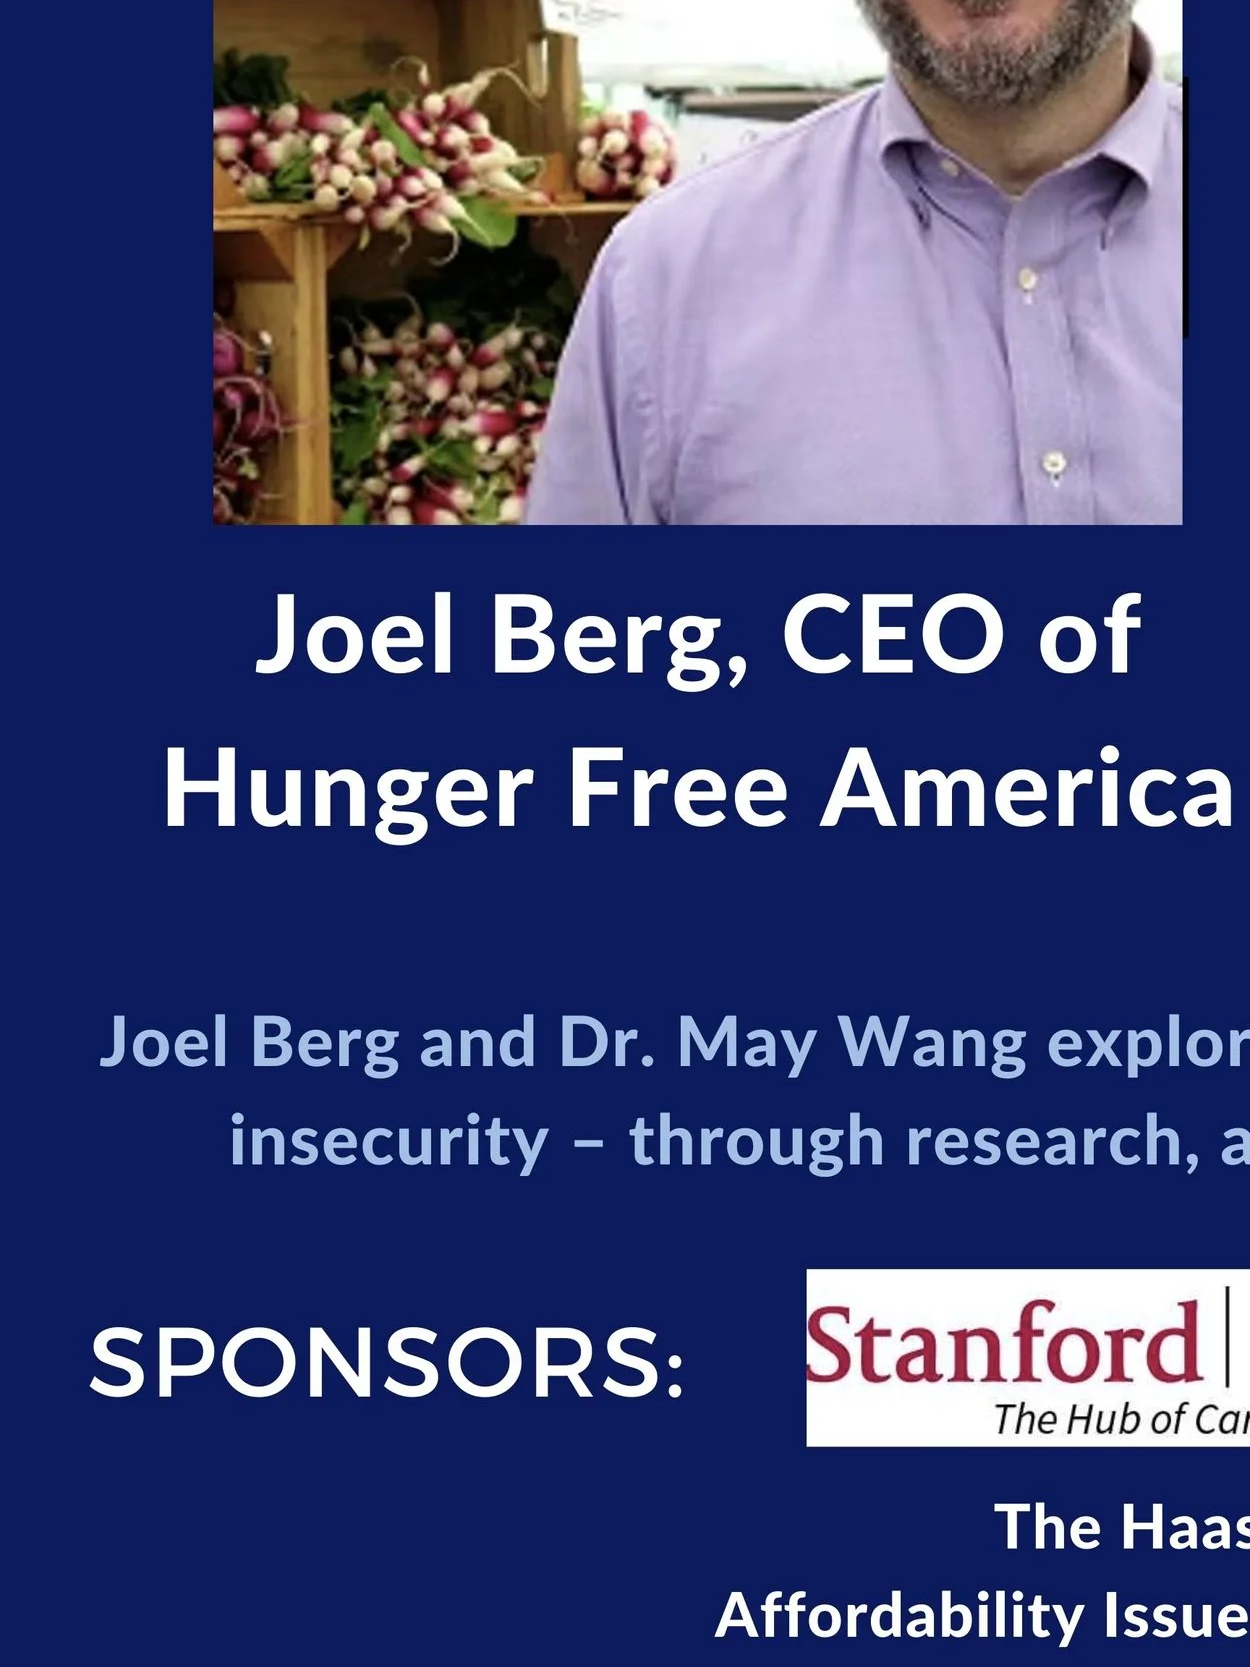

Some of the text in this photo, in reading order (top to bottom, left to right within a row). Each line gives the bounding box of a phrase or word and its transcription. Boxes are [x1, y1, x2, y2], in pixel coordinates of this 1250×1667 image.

[256, 592, 1141, 692] Joel Berg, CEO of
[167, 745, 1231, 846] Hunger Free America
[100, 1014, 225, 1067] Joel
[254, 1015, 399, 1079] Berg
[421, 1014, 534, 1067] and
[562, 1015, 653, 1067] Dr.
[680, 1015, 817, 1078] May
[837, 1015, 1026, 1079] Wang
[232, 1112, 549, 1176] insecurity
[629, 1112, 882, 1177] through
[909, 1112, 1198, 1174] research,
[89, 1327, 682, 1398] SPONSORS:
[807, 1299, 1204, 1384] Stanford
[995, 1401, 1057, 1435] The
[1067, 1401, 1141, 1434] Hub
[1151, 1401, 1190, 1434] of
[994, 1502, 1100, 1549] The
[714, 1590, 1085, 1647] Affordability
[1107, 1592, 1248, 1638] Issue
